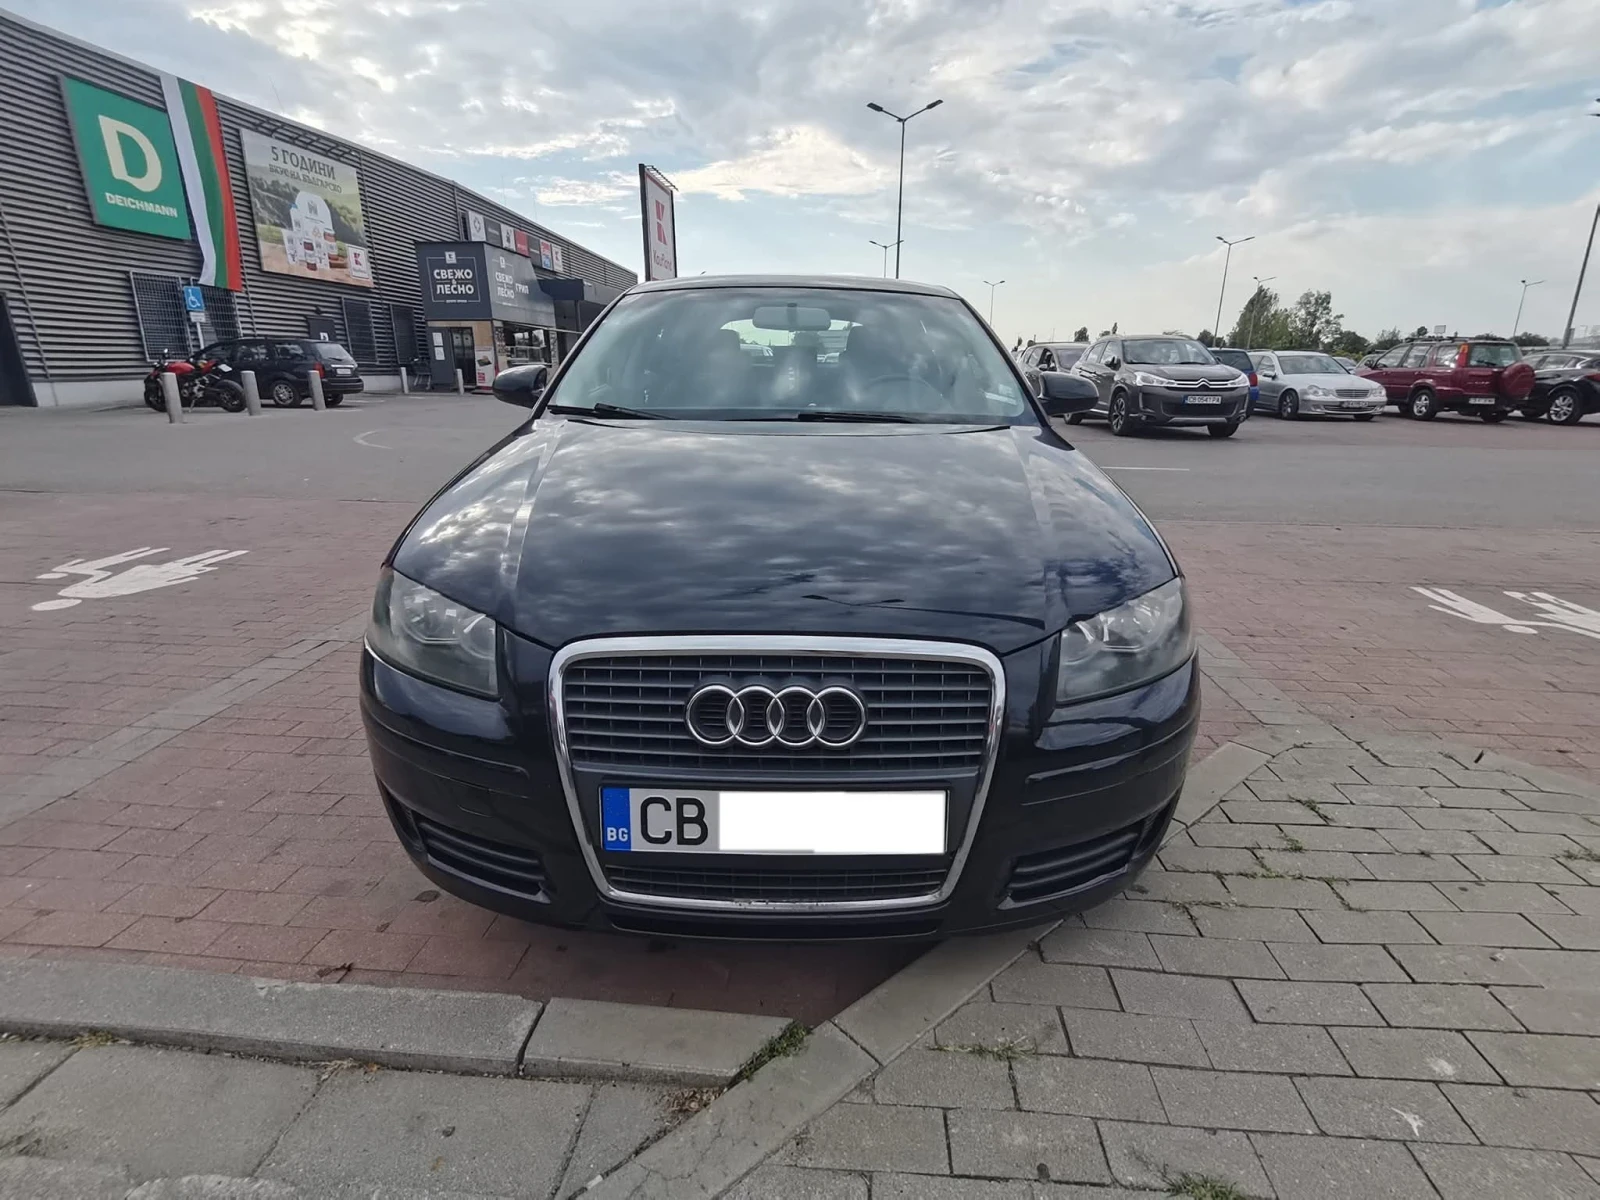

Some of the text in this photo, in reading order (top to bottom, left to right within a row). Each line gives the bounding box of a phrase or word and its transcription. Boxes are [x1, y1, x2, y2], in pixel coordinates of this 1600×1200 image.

[98, 114, 162, 192] D
[271, 146, 336, 180] 5 ГОДИНИ
[104, 192, 178, 218] DEICHMANN
[433, 269, 473, 279] СВЕЖО
[495, 272, 514, 285] СВЕЖО
[436, 284, 475, 295] ЛЕСНО
[497, 286, 515, 299] ЛЕСНО
[640, 796, 709, 846] CB
[607, 827, 629, 842] BG
